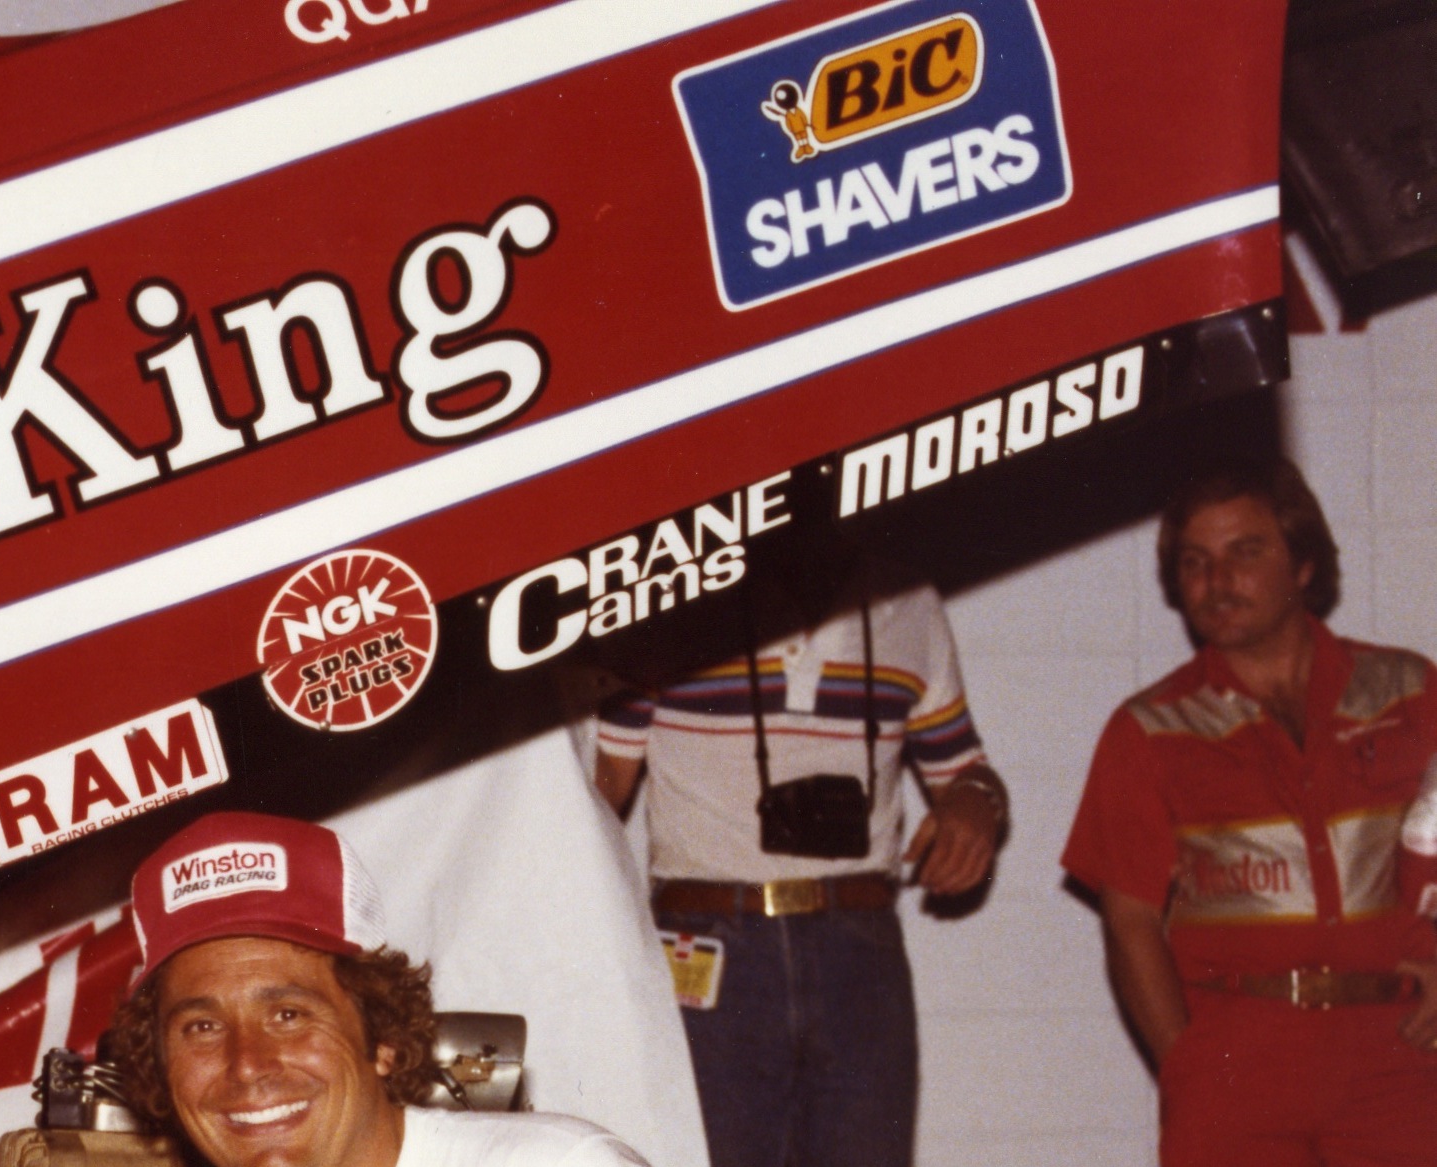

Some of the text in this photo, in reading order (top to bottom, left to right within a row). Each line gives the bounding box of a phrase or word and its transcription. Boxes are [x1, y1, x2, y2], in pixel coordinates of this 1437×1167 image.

[746, 114, 1040, 268] SHAVERS
[839, 346, 1144, 518] MOROSO
[282, 577, 398, 655] NGK
[299, 627, 405, 686] SPARK
[306, 653, 413, 713] PLUGS
[31, 787, 190, 854] RACING CLUTCHES
[171, 849, 276, 885] Winston
[173, 870, 277, 900] DRAG RACING
